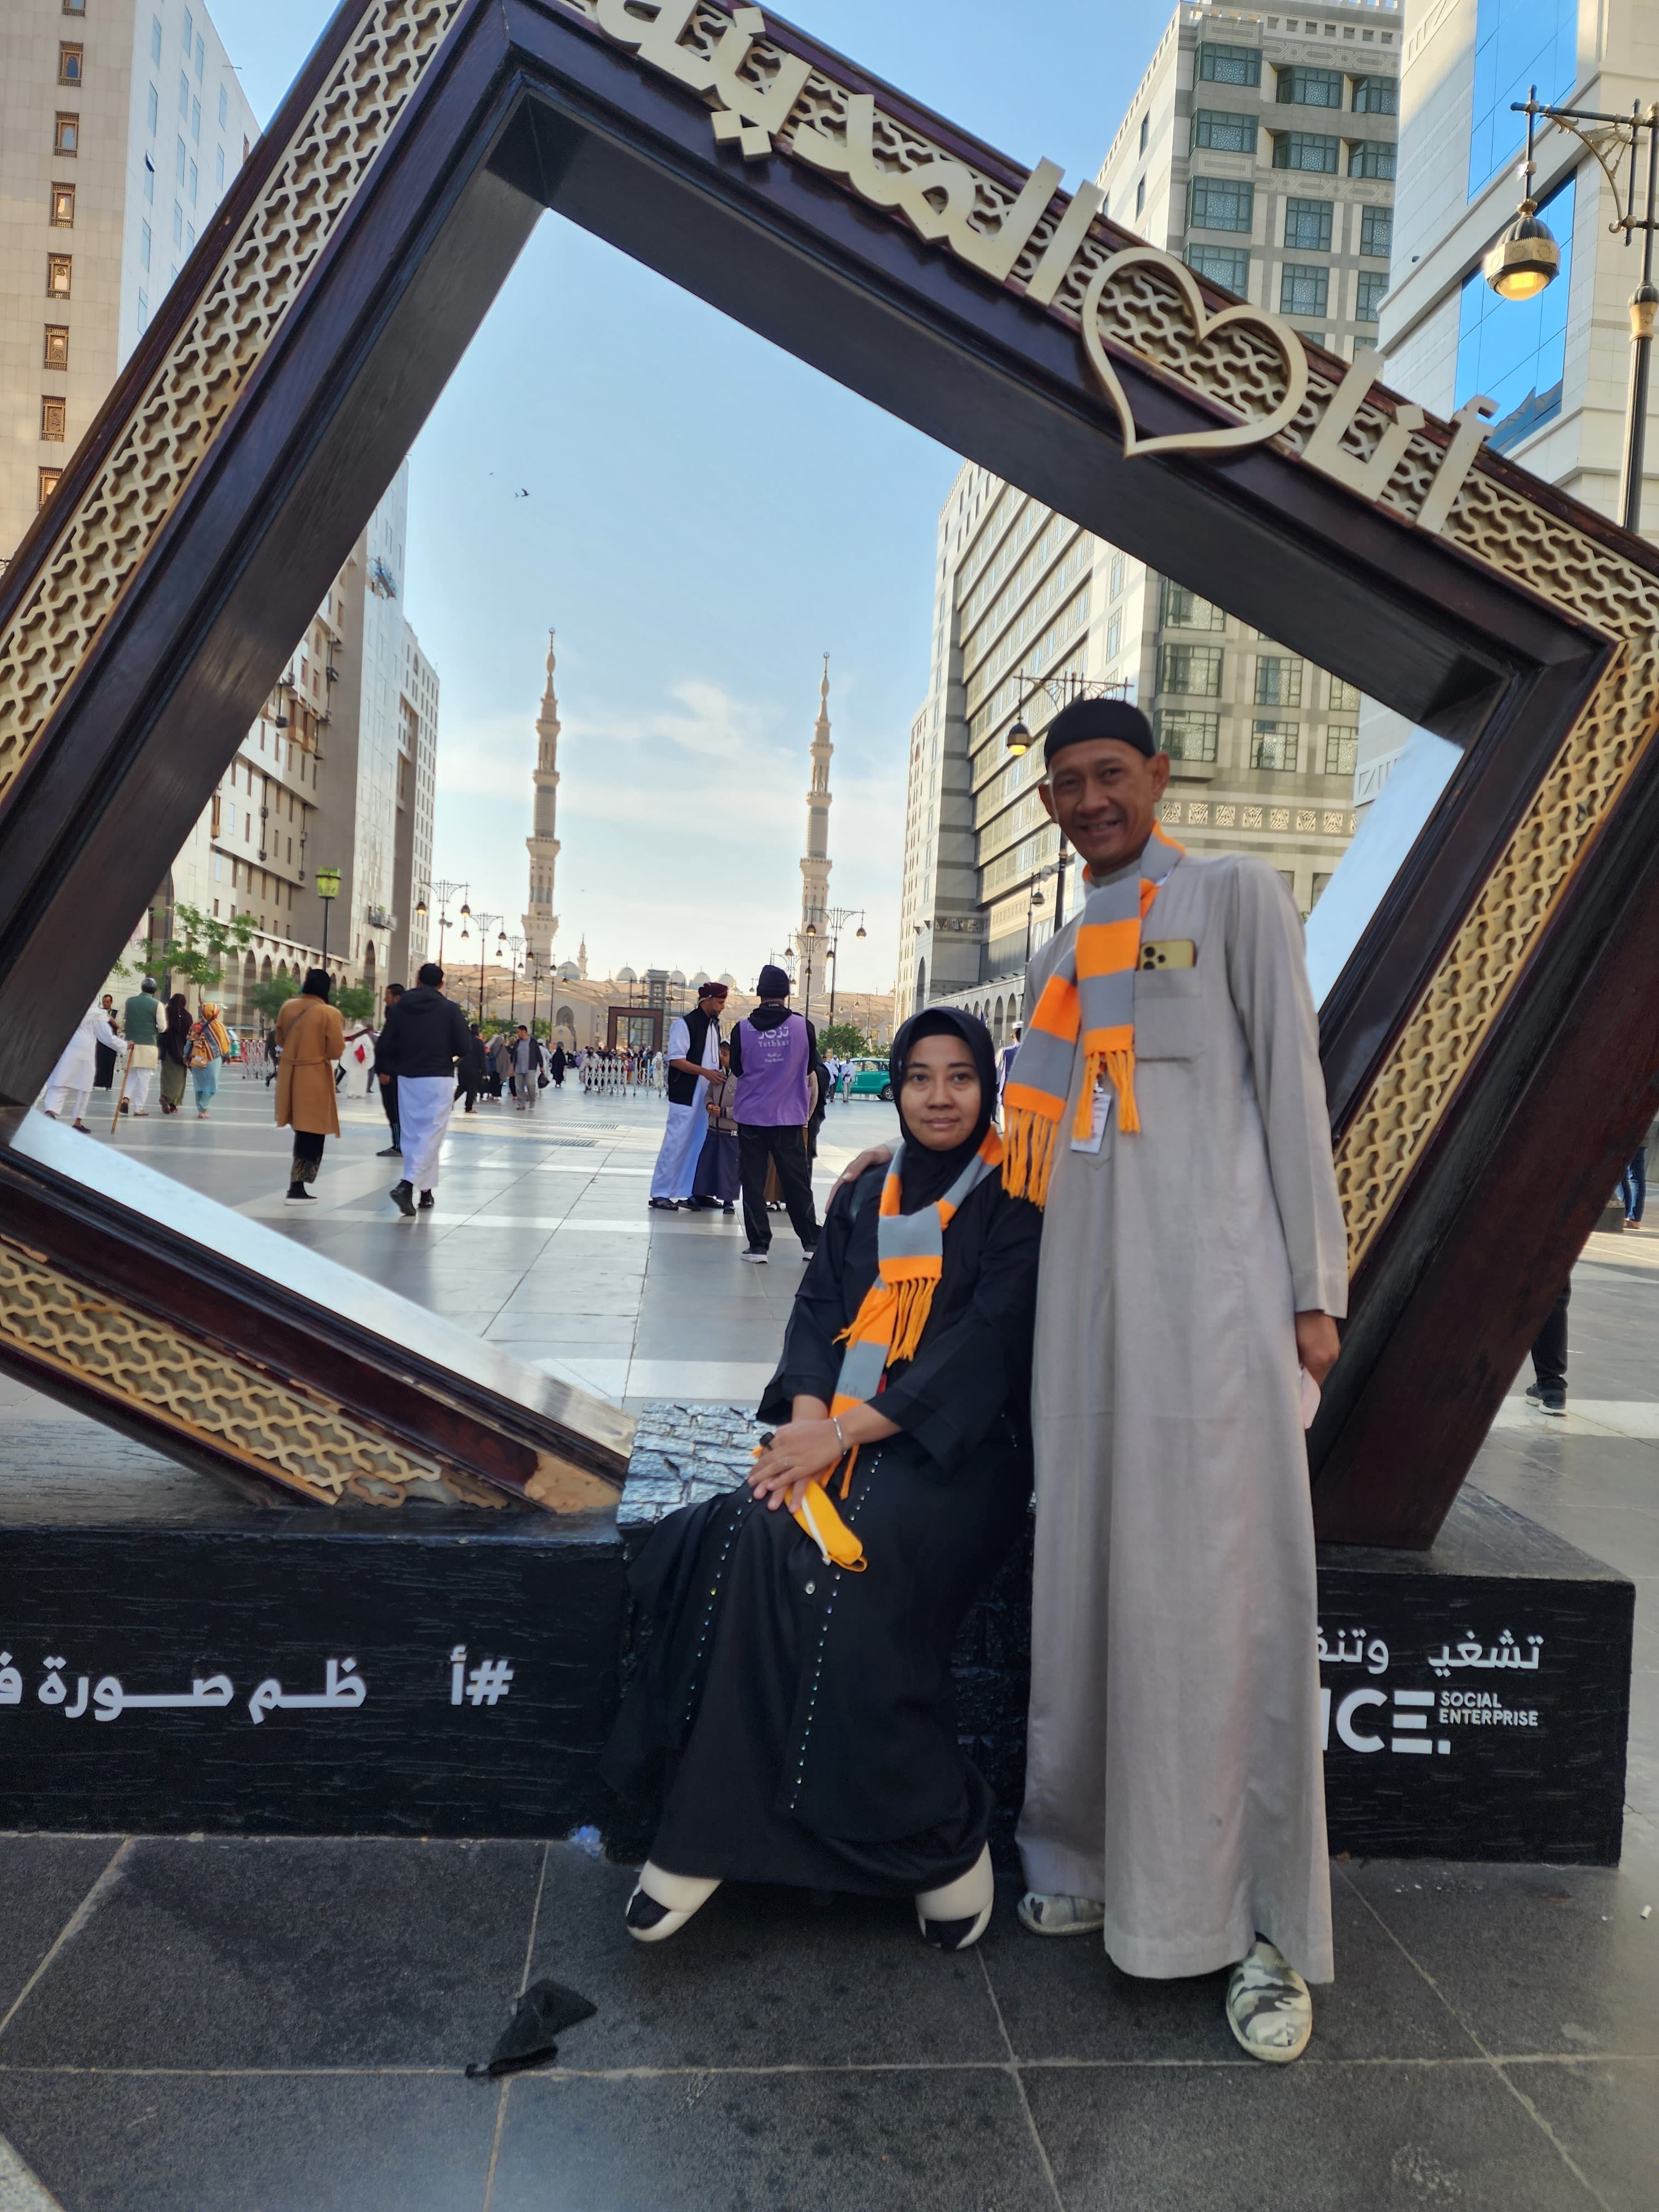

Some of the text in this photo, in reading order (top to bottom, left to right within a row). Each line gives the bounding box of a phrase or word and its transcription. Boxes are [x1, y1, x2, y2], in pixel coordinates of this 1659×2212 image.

[1300, 345, 1500, 535] أنا
[1440, 1691, 1502, 1708] SOCIAL
[1439, 1709, 1538, 1726] ENTERPRISE
